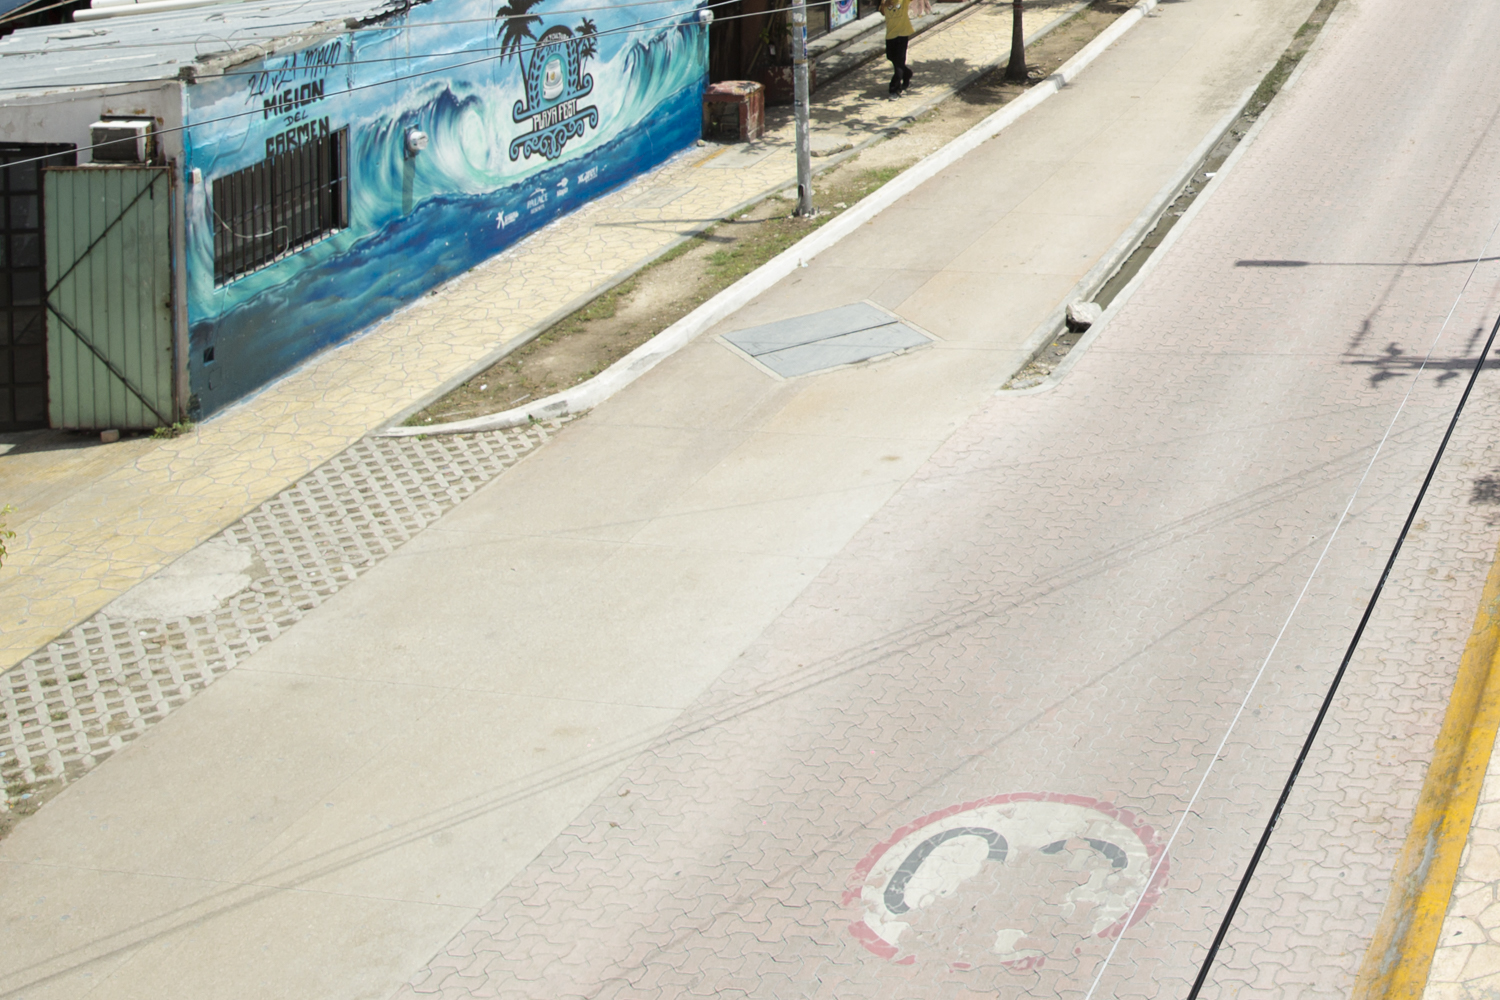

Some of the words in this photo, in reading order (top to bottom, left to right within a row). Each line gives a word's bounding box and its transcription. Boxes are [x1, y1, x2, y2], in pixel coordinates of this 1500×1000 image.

[245, 71, 269, 105] 20
[276, 52, 297, 91] 21
[304, 41, 341, 79] MAYO
[263, 79, 325, 120] MISION
[533, 106, 557, 131] PLAYA
[558, 98, 577, 121] FEST
[266, 116, 330, 158] CARMEN
[283, 110, 309, 127] DEL
[527, 193, 548, 210] PALACE
